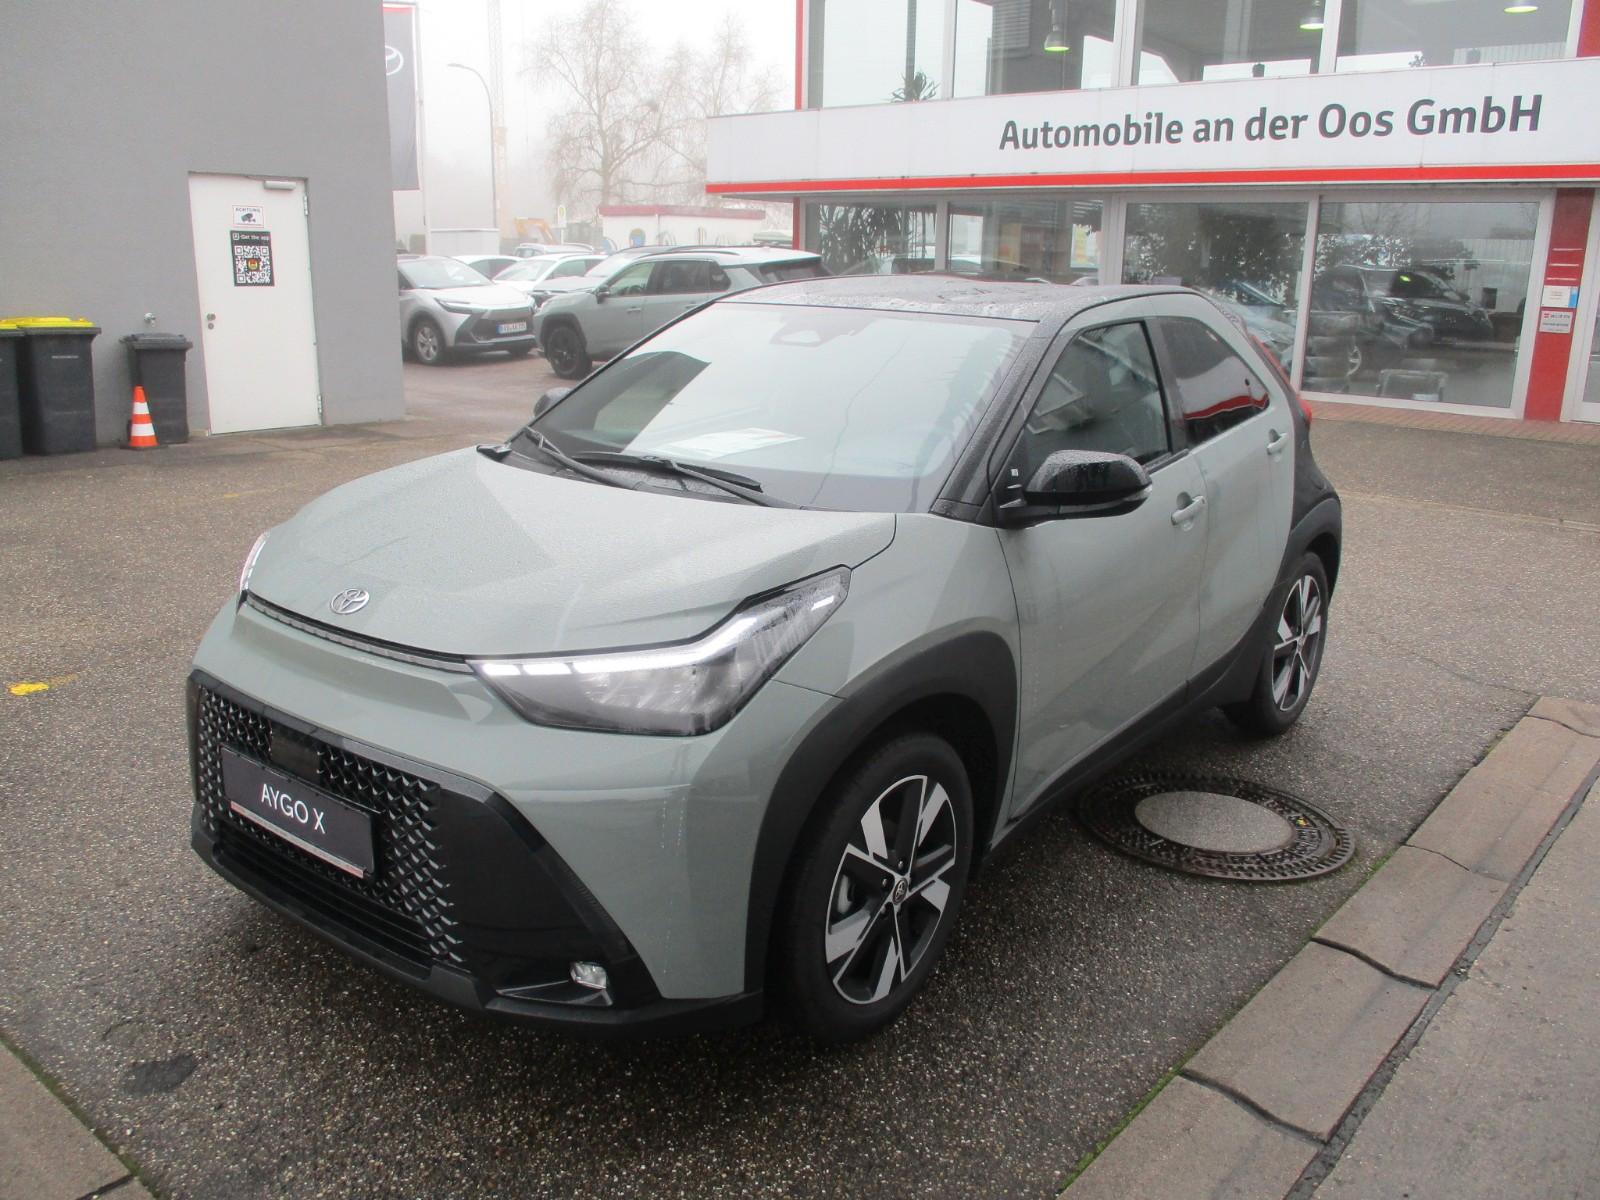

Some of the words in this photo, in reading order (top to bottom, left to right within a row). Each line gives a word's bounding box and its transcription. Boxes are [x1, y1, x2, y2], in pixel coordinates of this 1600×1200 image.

[999, 111, 1184, 151] Automobile
[1192, 117, 1234, 143] an
[1244, 106, 1309, 142] der
[1318, 102, 1394, 139] Oos
[1406, 94, 1543, 136] GmbH
[260, 783, 309, 824] AYGO
[313, 807, 326, 835] X
